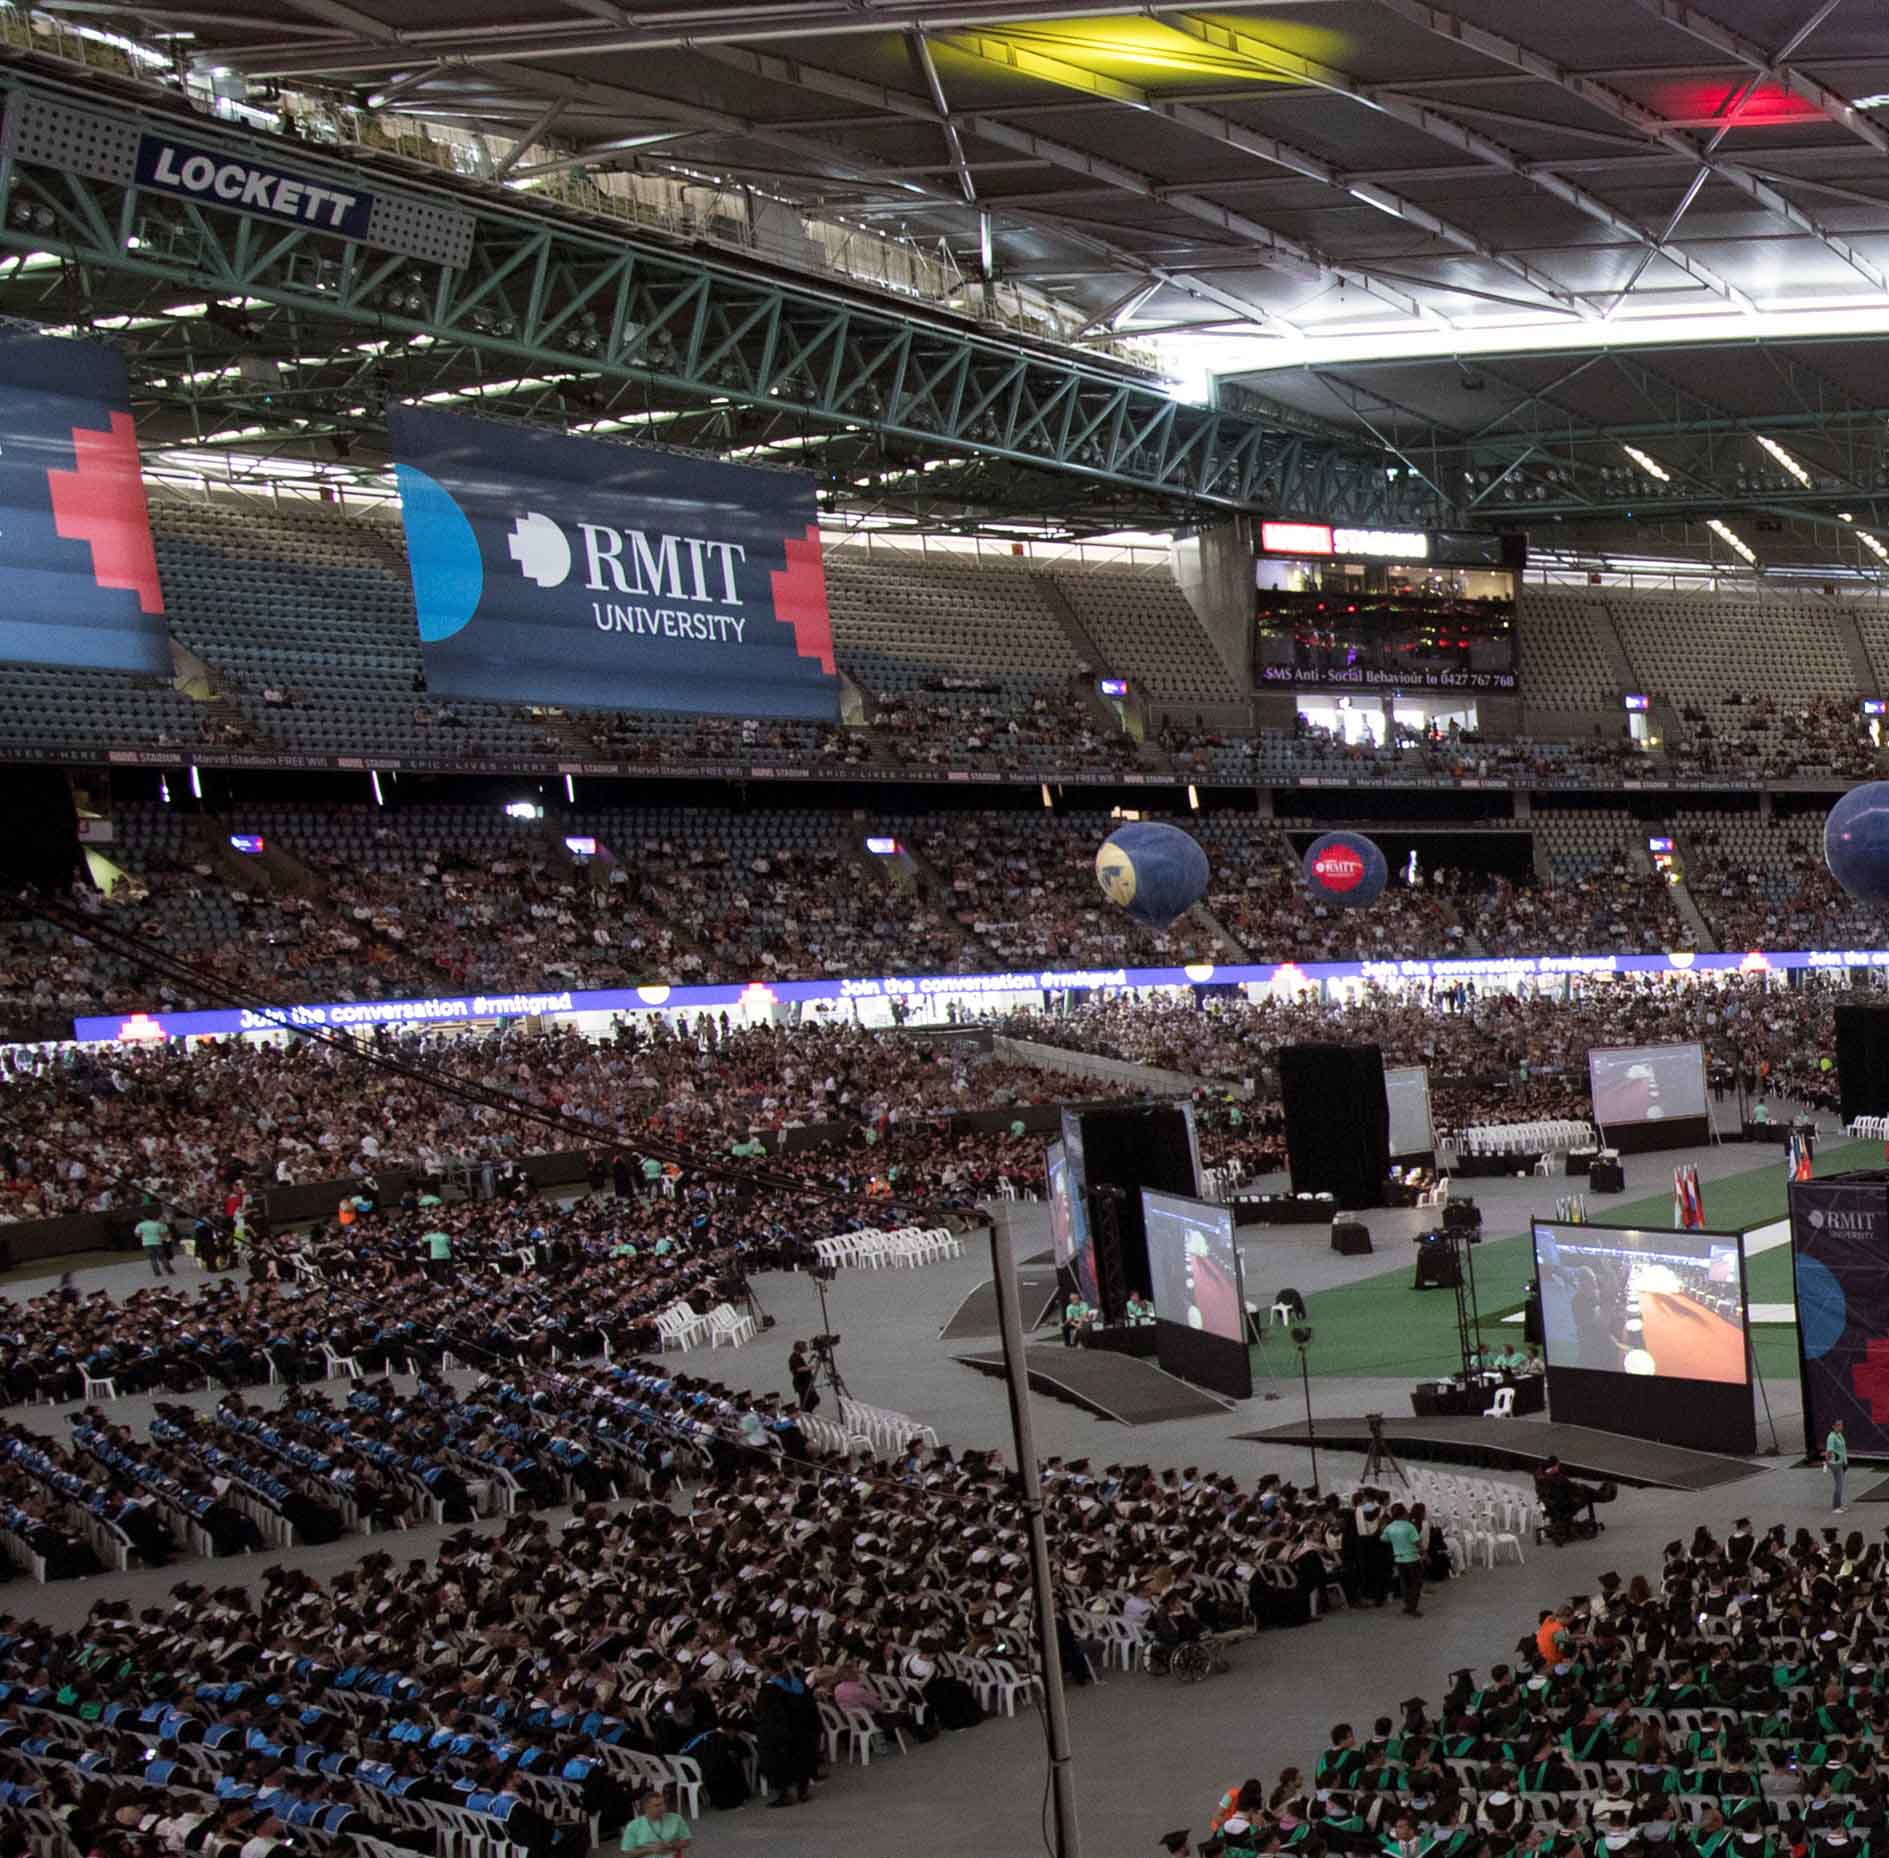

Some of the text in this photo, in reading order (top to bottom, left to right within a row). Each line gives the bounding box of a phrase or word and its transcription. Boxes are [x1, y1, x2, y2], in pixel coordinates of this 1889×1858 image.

[153, 147, 356, 226] LOCKETT
[577, 522, 746, 605] RMIT
[592, 602, 746, 643] UNIVERSITY
[1264, 667, 1292, 681] SMS
[1295, 668, 1319, 682] Anti
[1328, 669, 1362, 683] Social
[1366, 669, 1422, 684] Behaviour
[1362, 961, 1398, 976] Join
[1401, 959, 1429, 974] the
[1844, 949, 1869, 965] the
[840, 979, 880, 997] Join
[884, 977, 915, 994] the
[919, 974, 1036, 993] conversation
[291, 1004, 326, 1025] the
[331, 998, 467, 1023] conversation
[473, 992, 574, 1016] #rmitgrad
[1826, 1211, 1874, 1230] RMIT
